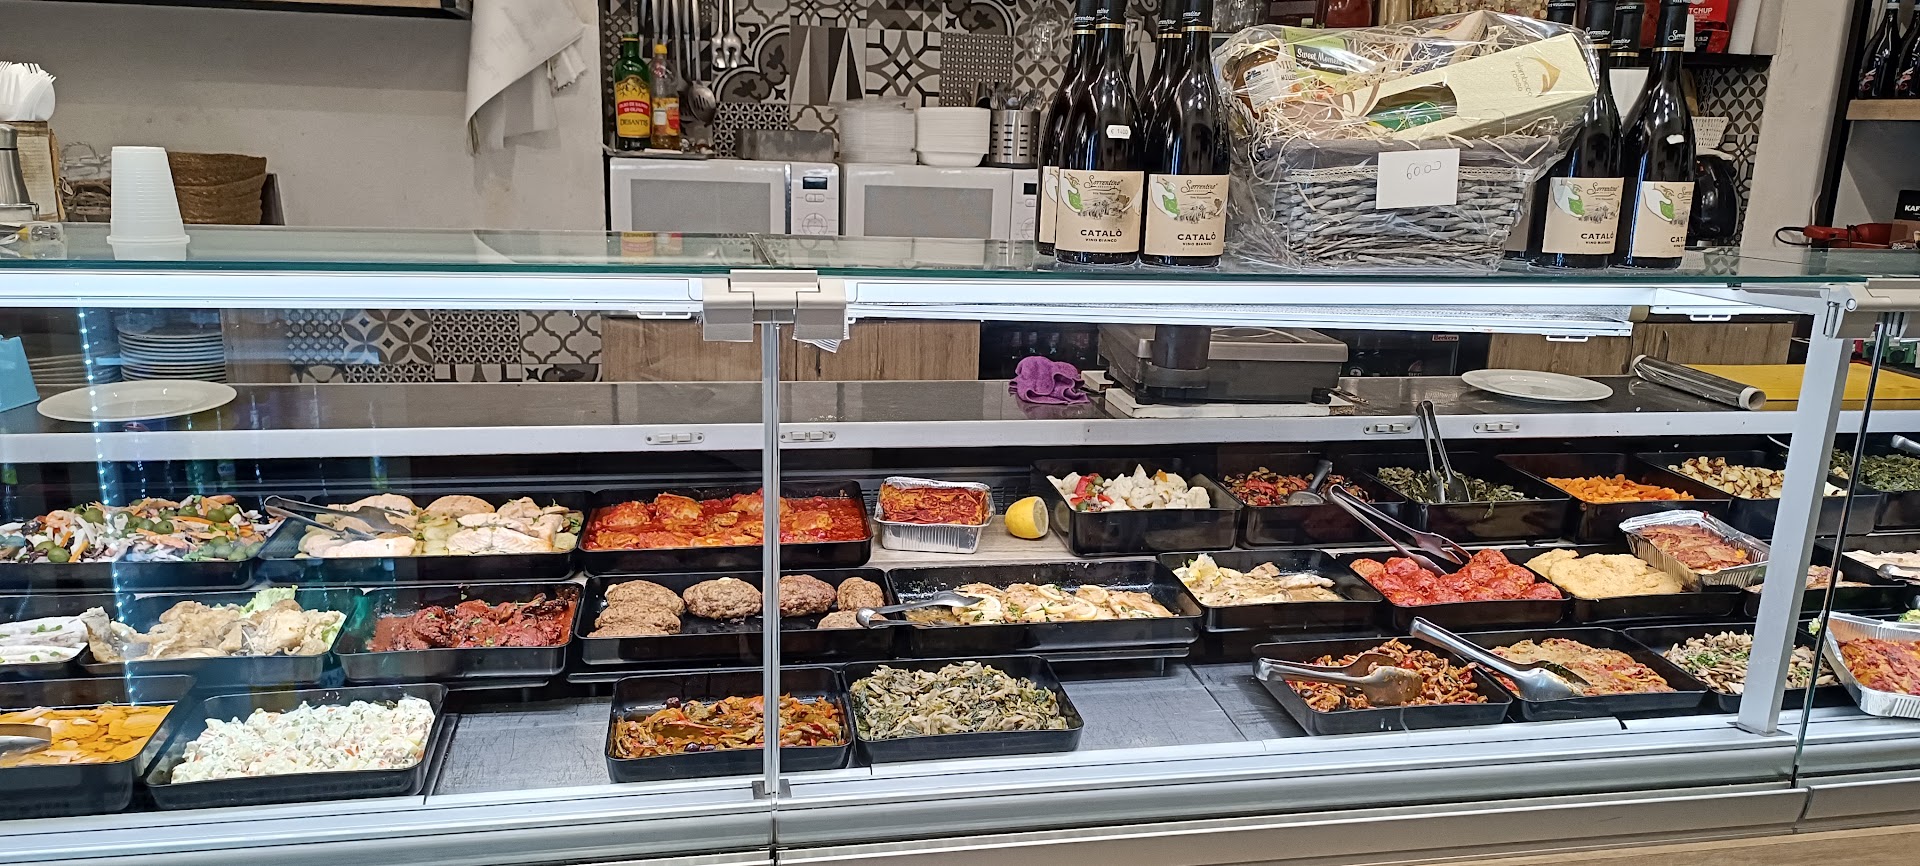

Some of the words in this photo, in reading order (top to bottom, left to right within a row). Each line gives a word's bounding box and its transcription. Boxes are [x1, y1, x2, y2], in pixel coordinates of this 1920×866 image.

[1296, 48, 1316, 60] Sweet
[1511, 70, 1522, 92] rosso
[1081, 228, 1122, 237] CATALÒ
[1177, 232, 1216, 240] CATALÒ
